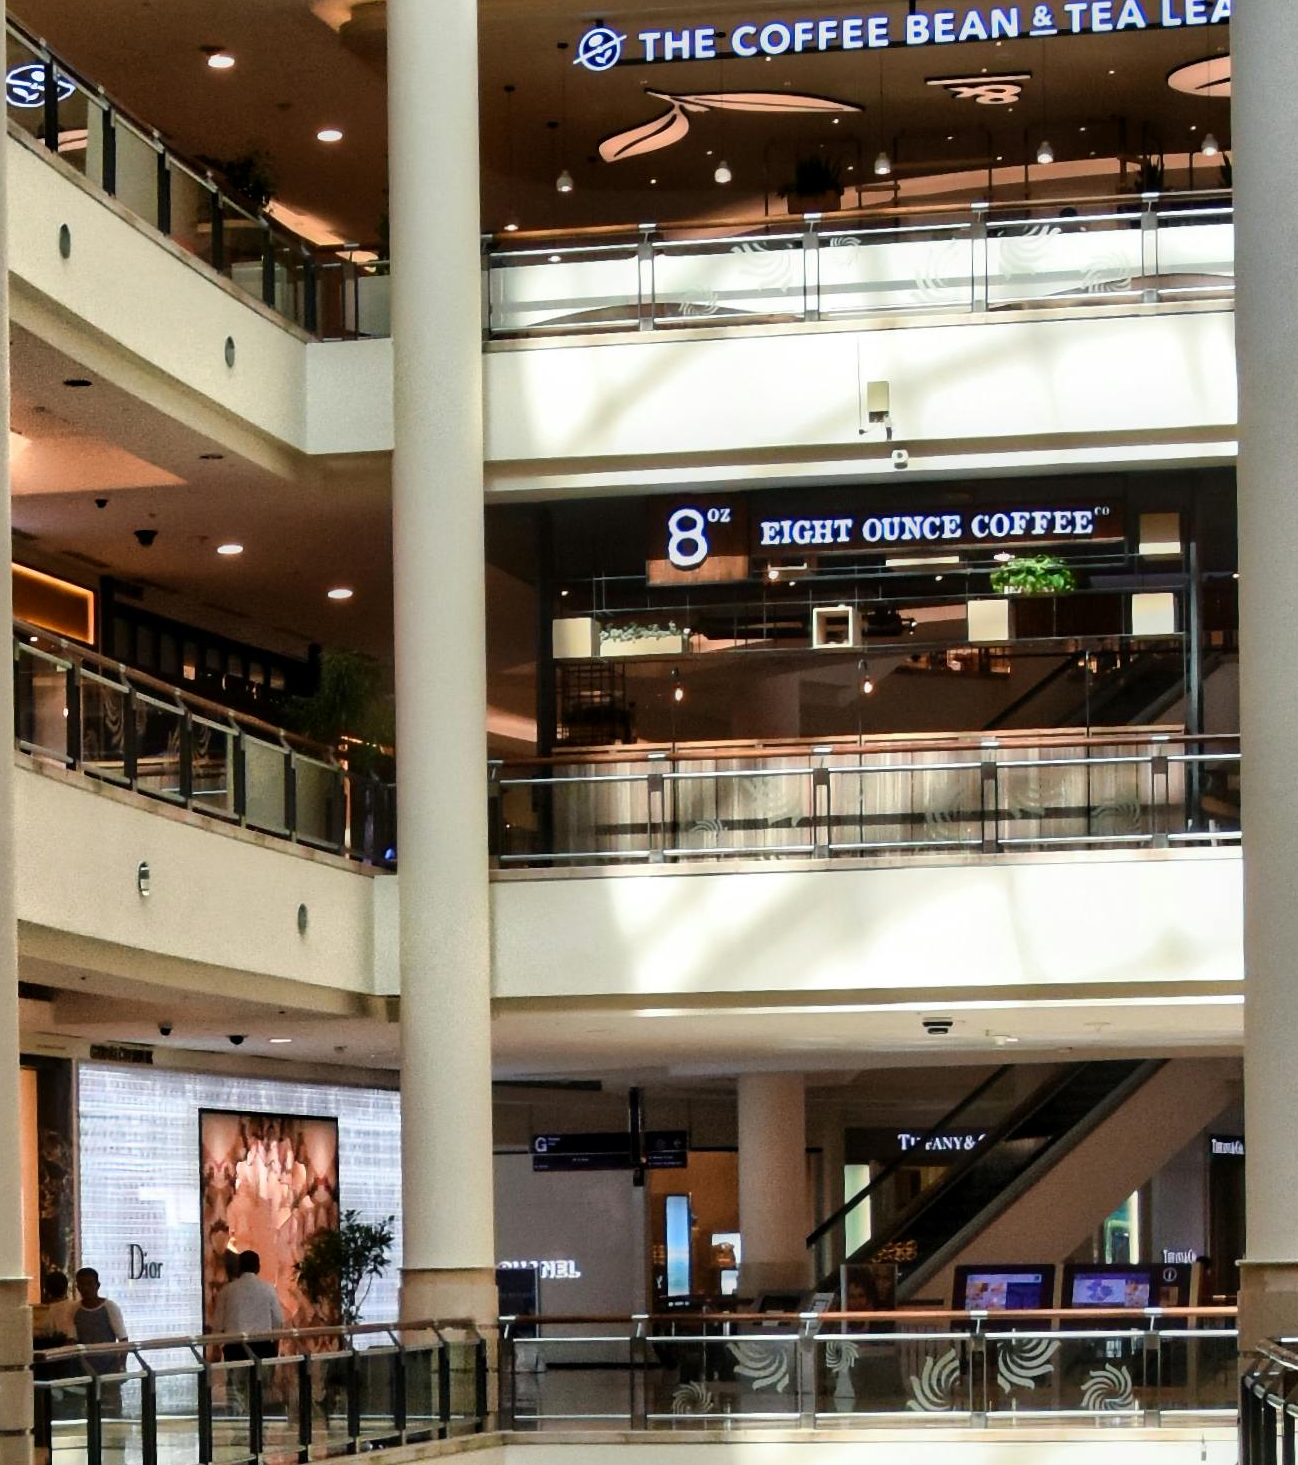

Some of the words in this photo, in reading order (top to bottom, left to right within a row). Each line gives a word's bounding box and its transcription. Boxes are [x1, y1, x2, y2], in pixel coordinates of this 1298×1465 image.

[639, 27, 716, 62] THE
[731, 16, 890, 56] COFFEE
[906, 6, 1019, 46] BEAN
[1031, 4, 1058, 36] &
[668, 507, 708, 567] 8
[760, 518, 854, 546] EIGHT
[862, 514, 963, 543] OUNCE
[971, 510, 1094, 538] COFFEE
[535, 1136, 548, 1152] G
[127, 1243, 164, 1279] Dior
